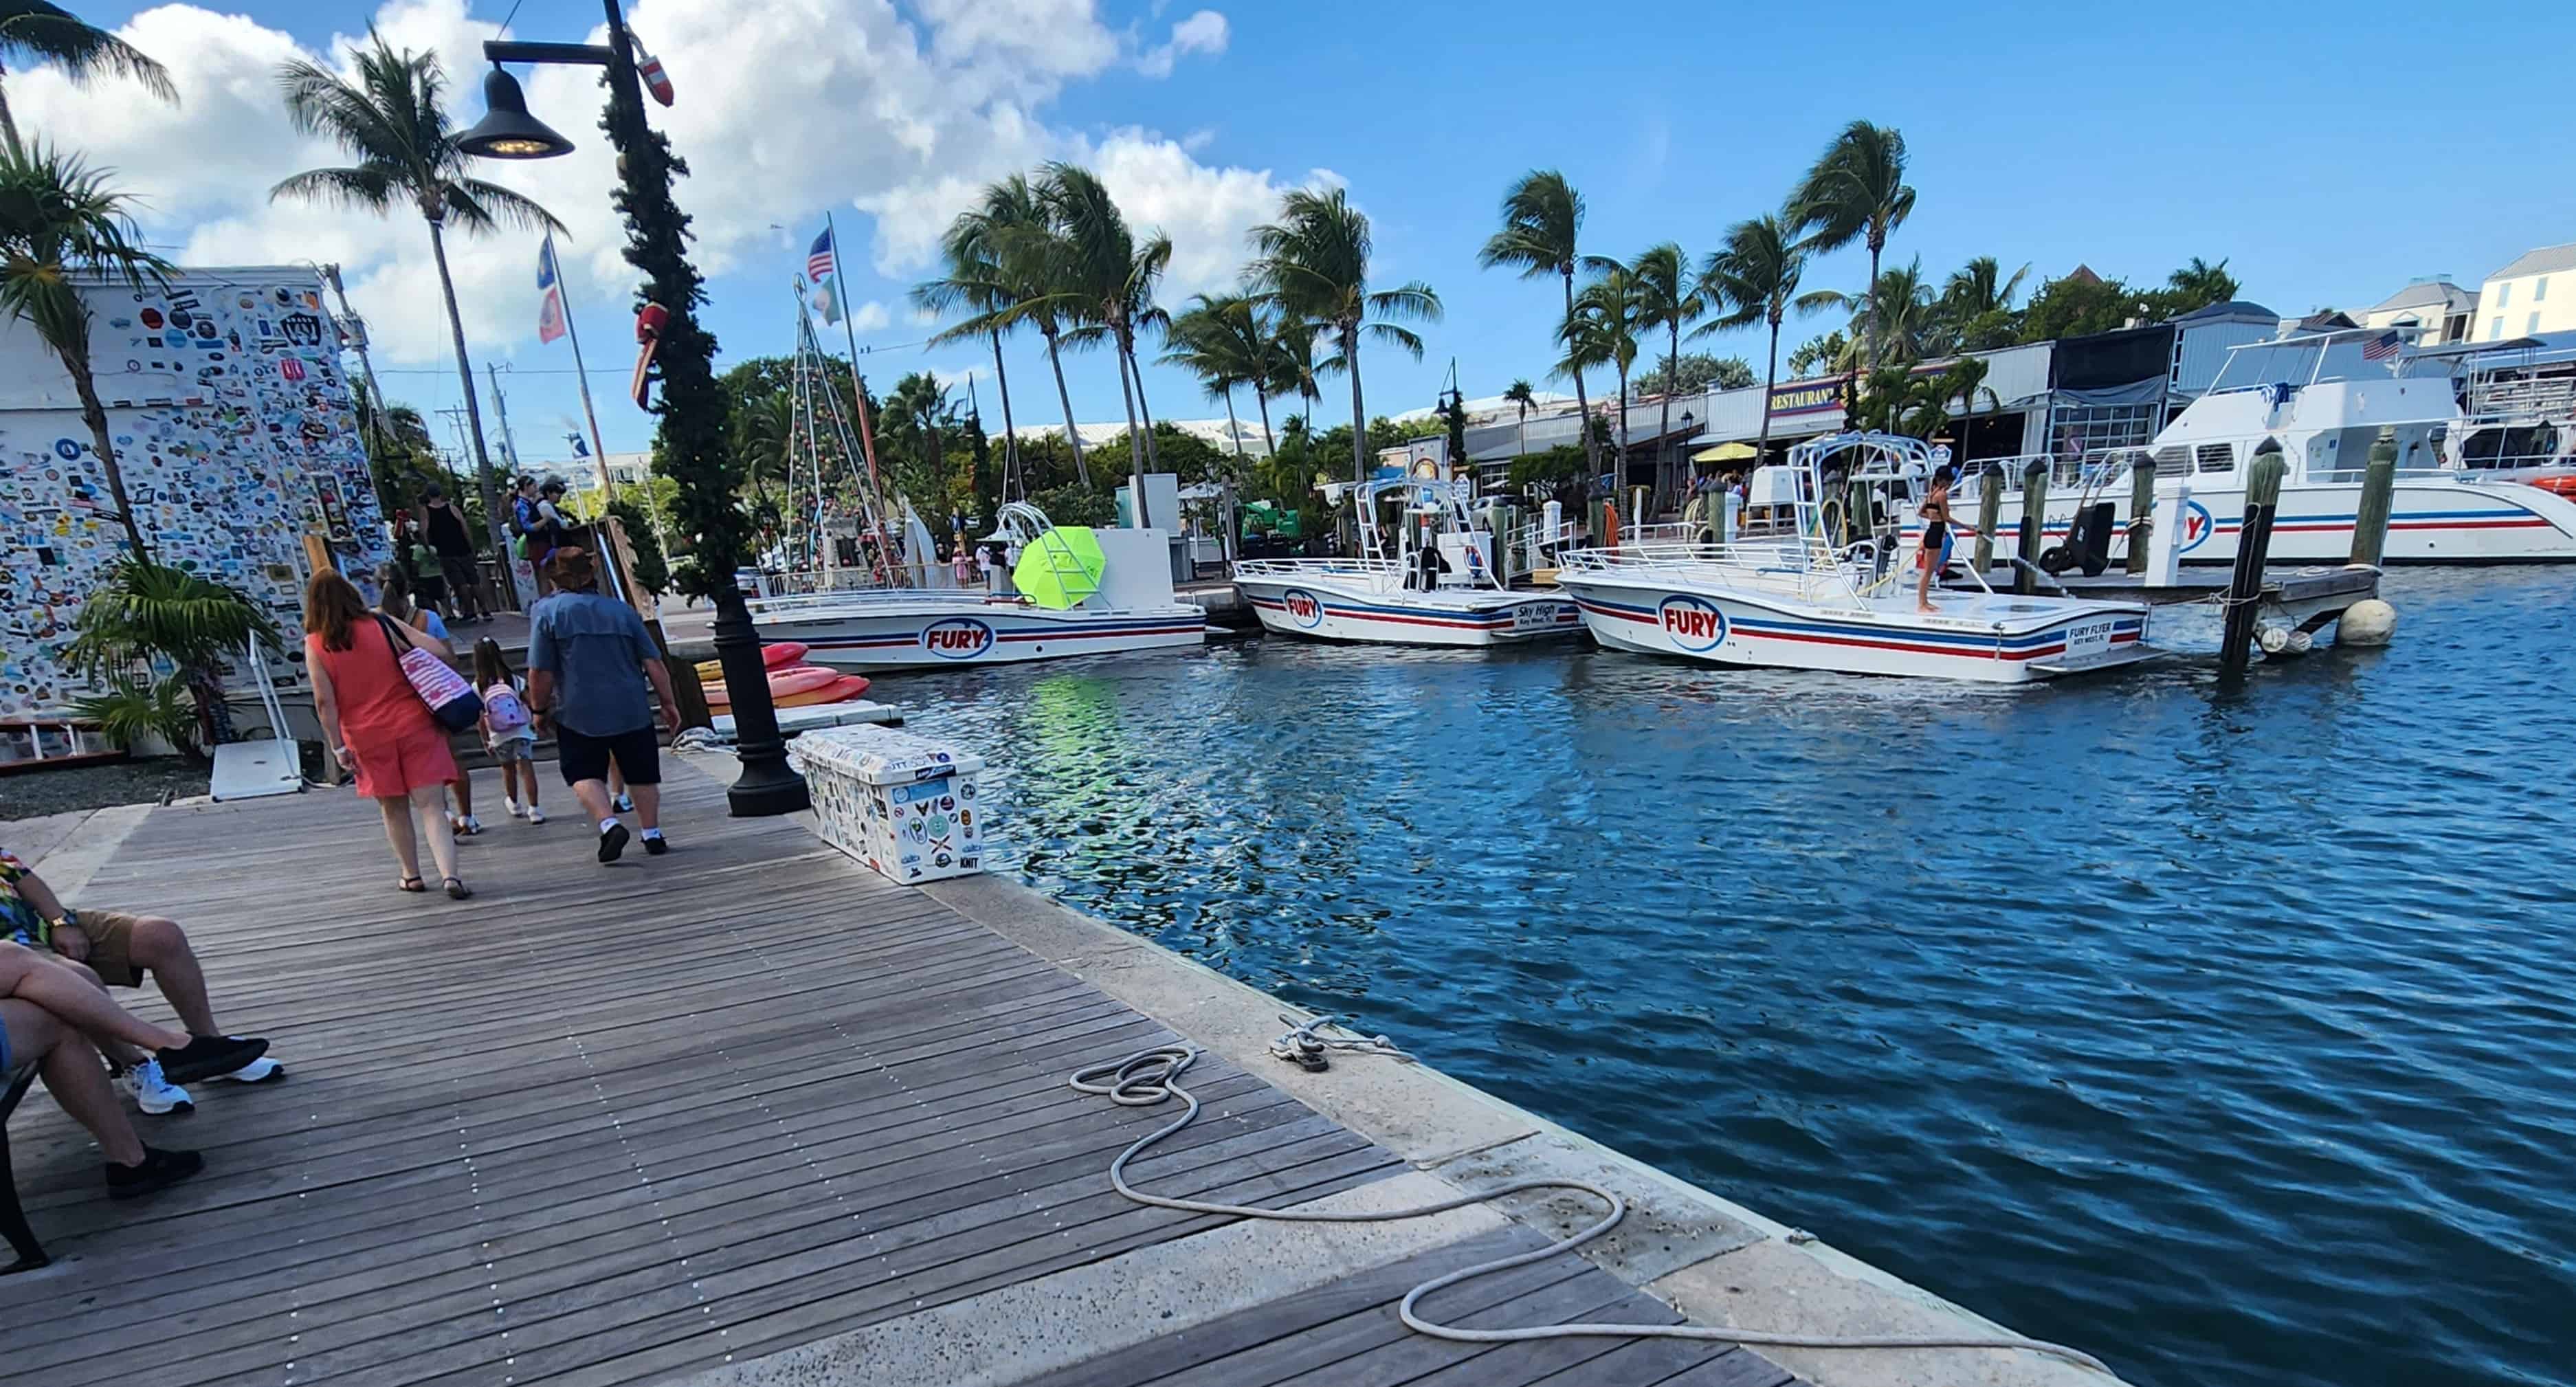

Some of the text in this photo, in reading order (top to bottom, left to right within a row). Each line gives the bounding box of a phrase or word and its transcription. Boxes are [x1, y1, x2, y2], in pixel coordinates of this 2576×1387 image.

[1287, 598, 1315, 618] FURY
[1518, 604, 1555, 617] Sky High
[1665, 608, 1718, 639] FURY
[2069, 622, 2111, 638] FURY FLYER
[927, 630, 986, 649] FURY
[960, 857, 979, 869] KNIT
